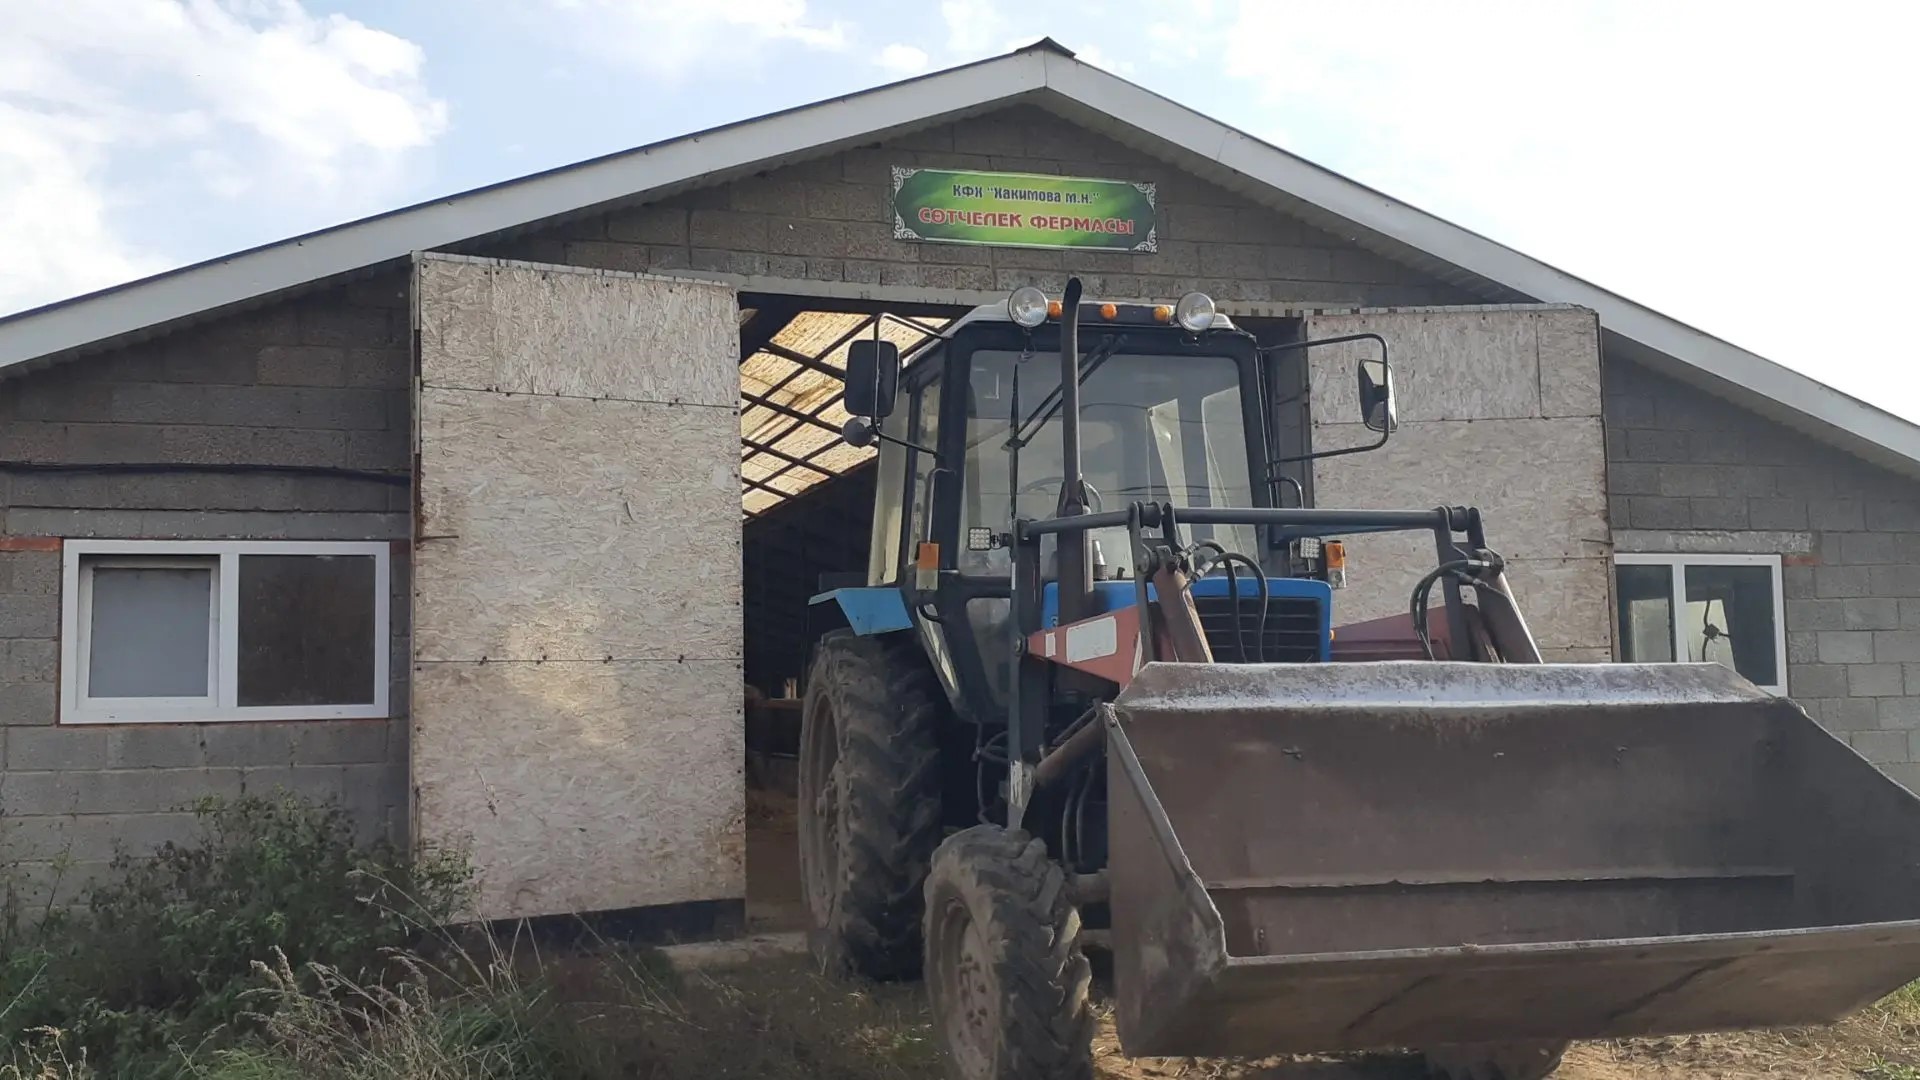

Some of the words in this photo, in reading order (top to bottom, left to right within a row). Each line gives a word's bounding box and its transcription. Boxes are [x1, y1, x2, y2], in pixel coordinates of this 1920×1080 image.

[952, 184, 983, 198] КФХ
[918, 207, 1023, 228] СӨТЧЕЛЕК
[1029, 213, 1135, 235] ФЕРМАСЫ
